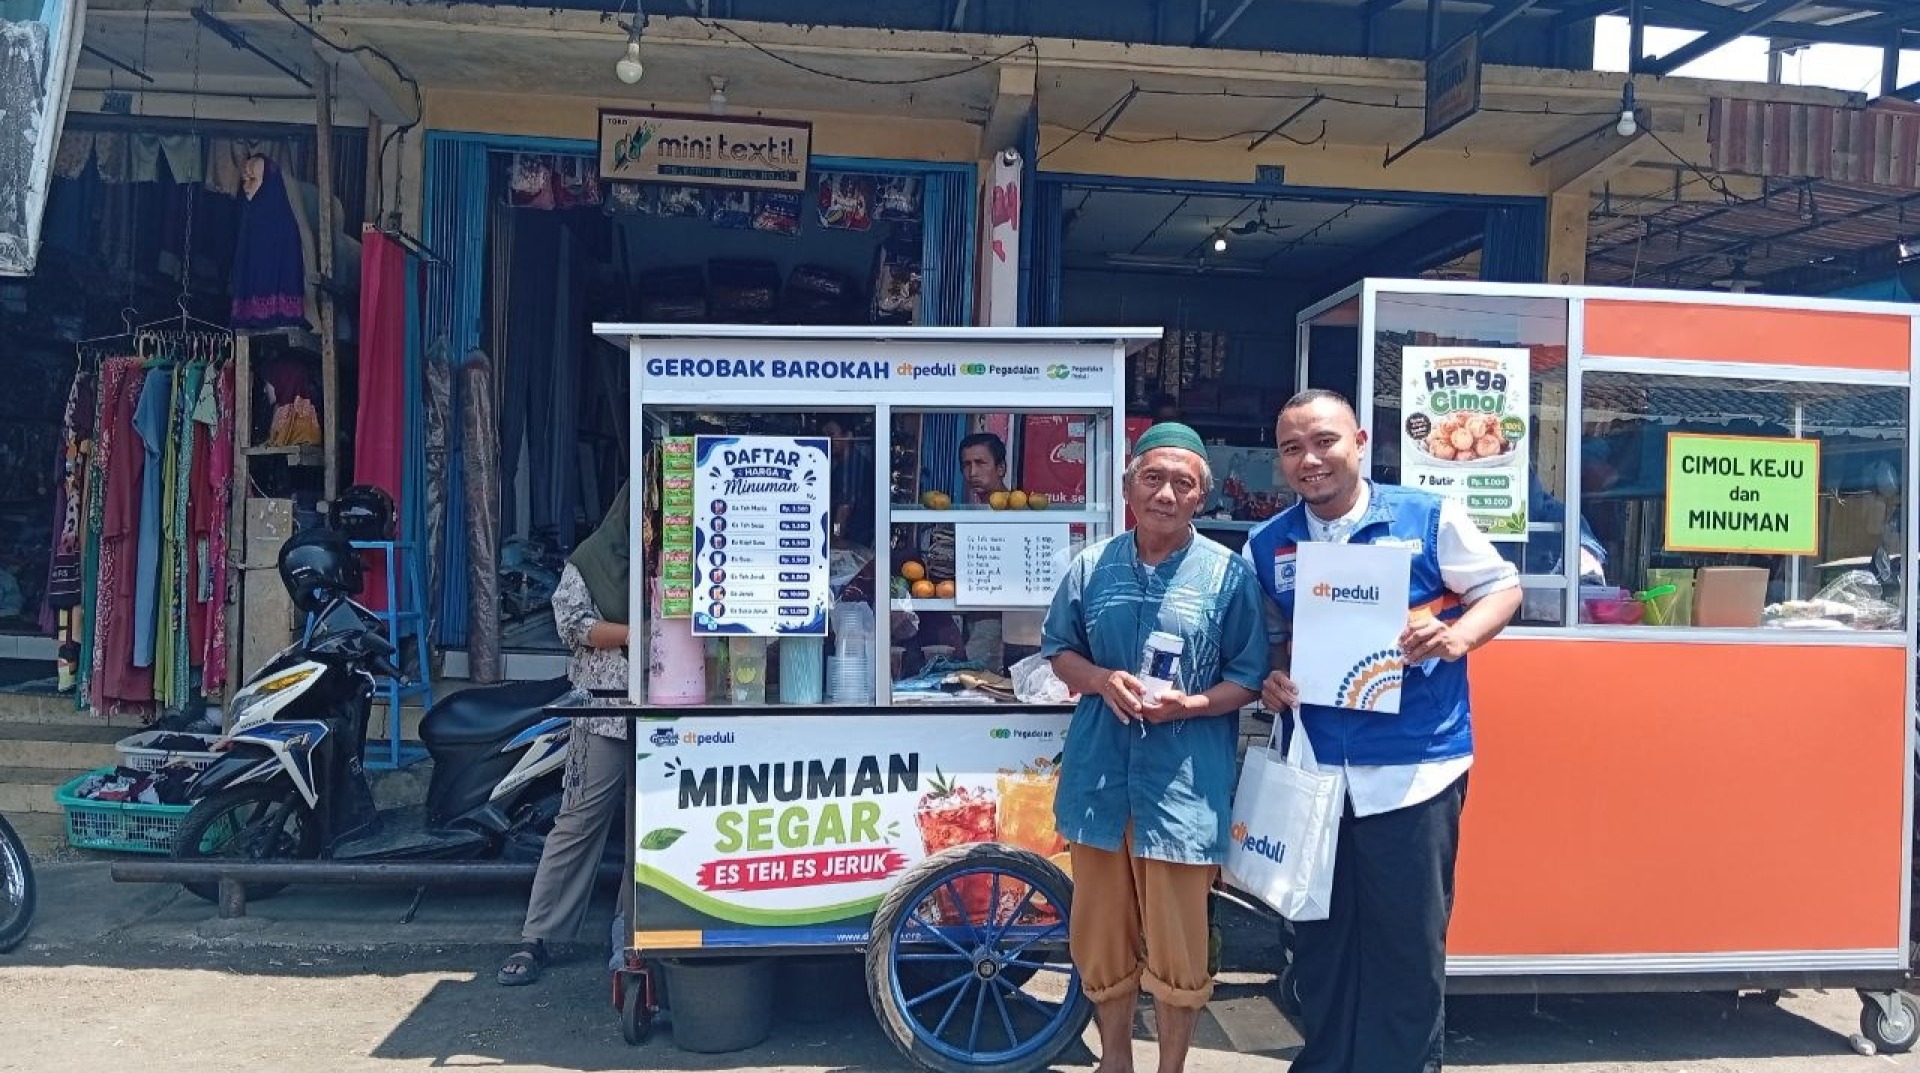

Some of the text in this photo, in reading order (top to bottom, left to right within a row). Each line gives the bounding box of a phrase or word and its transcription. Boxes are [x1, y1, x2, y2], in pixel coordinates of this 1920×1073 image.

[658, 134, 799, 168] mini textil
[646, 358, 766, 378] GEROBAK
[771, 359, 889, 380] BAROKAH
[896, 362, 956, 381] dtpeduli
[1425, 368, 1507, 393] Harga
[1430, 390, 1505, 414] Cimol
[724, 448, 800, 467] DAFTAR
[1681, 455, 1804, 479] CIMOL KEJU
[744, 467, 779, 478] HARGA
[1419, 475, 1426, 486] 7
[1429, 475, 1455, 486] Butir
[723, 478, 800, 496] Minuman
[1729, 486, 1760, 501] dan
[1689, 510, 1789, 533] MINUMAN
[1312, 582, 1380, 601] dtpeduli
[683, 732, 735, 746] dtpeduli
[678, 752, 919, 810] MINUMAN
[713, 801, 882, 853] SEGAR
[715, 854, 887, 885] ES TEH, ES JERUK
